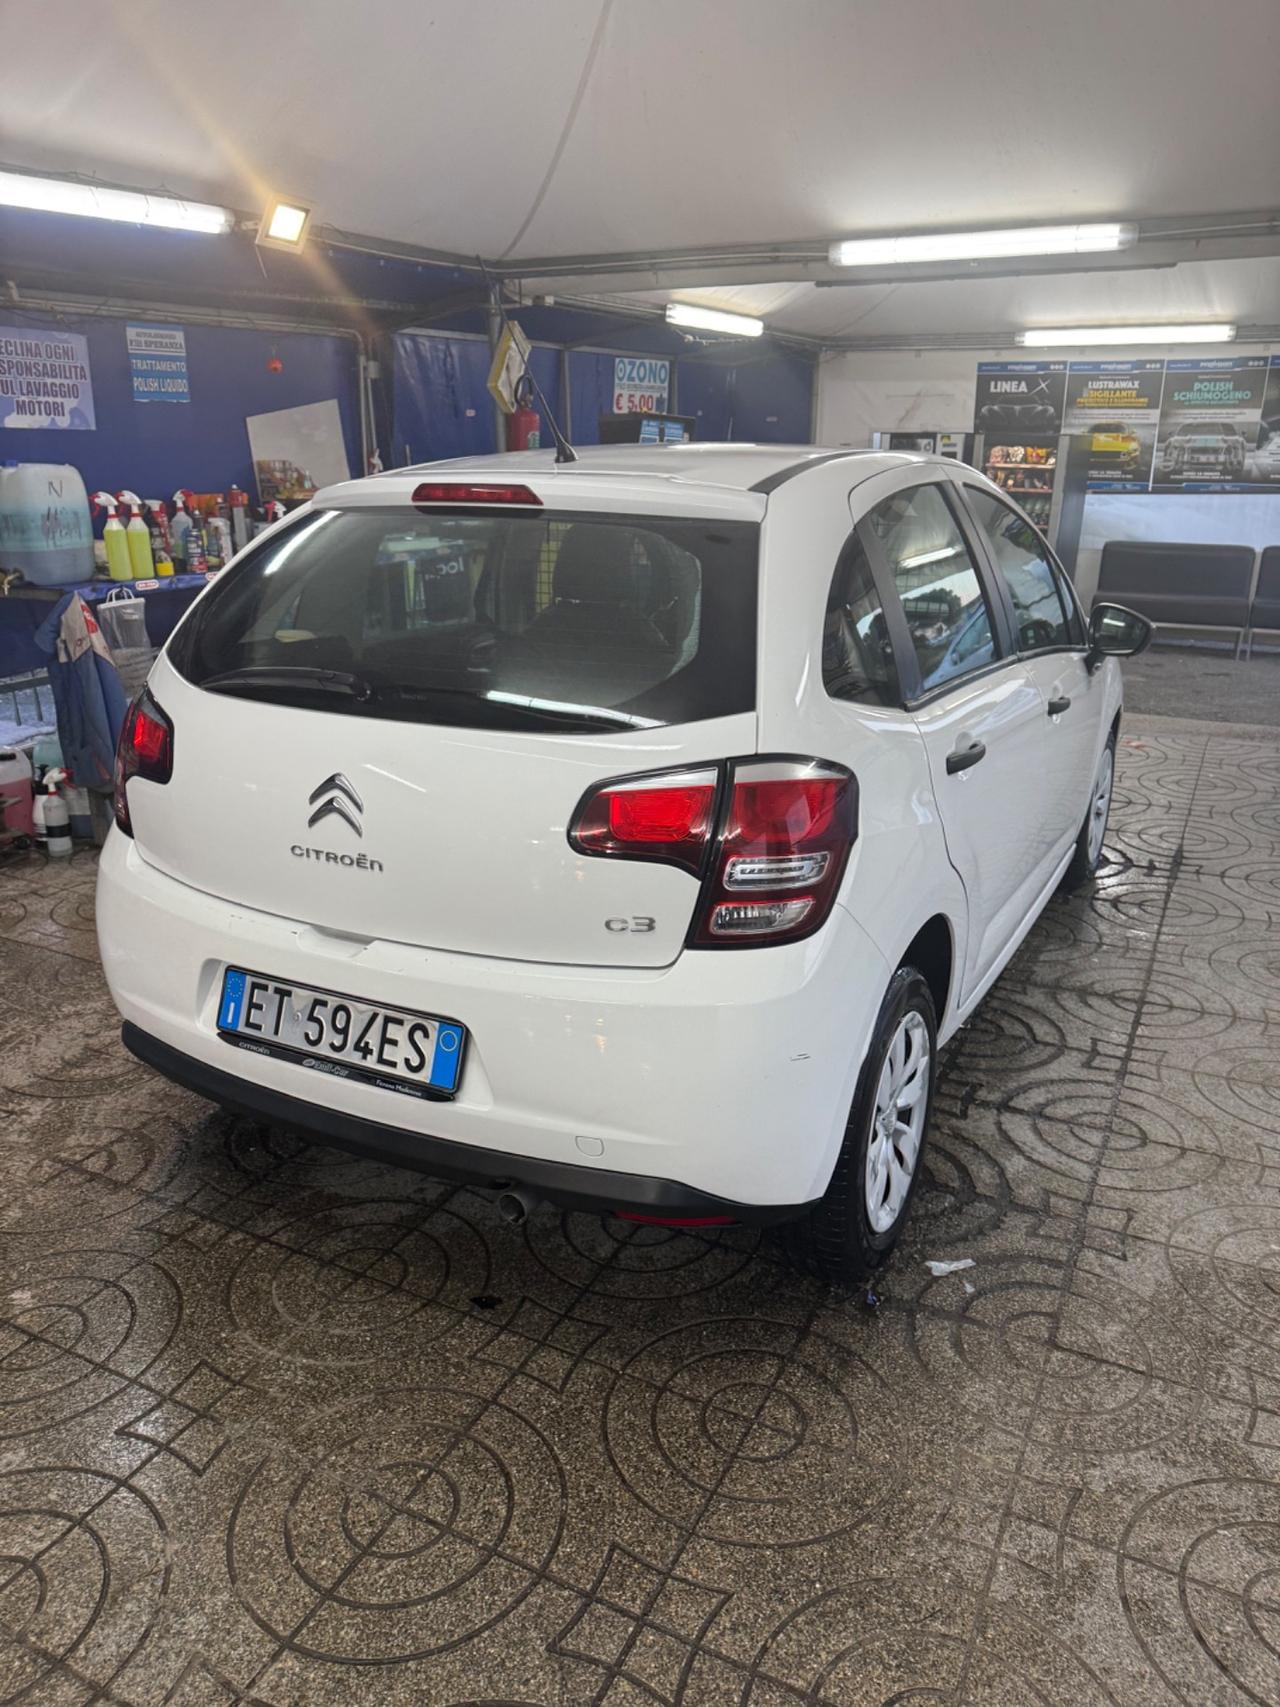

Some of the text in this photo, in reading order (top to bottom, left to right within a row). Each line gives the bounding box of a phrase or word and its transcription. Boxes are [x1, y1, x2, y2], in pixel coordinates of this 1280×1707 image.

[45, 343, 75, 361] OGNI
[131, 359, 187, 372] TRATTAMENTO
[616, 359, 668, 385] OZONO
[19, 380, 80, 399] LAVAGGIO
[133, 376, 189, 393] POLISH LIQUIDO
[990, 380, 1028, 393] LINEA
[1193, 381, 1233, 392] POLISH
[1173, 390, 1252, 401] SCHIUMOGENO
[16, 400, 65, 417] MOTORI
[604, 916, 656, 933] C3
[244, 981, 430, 1074] ET 594ES
